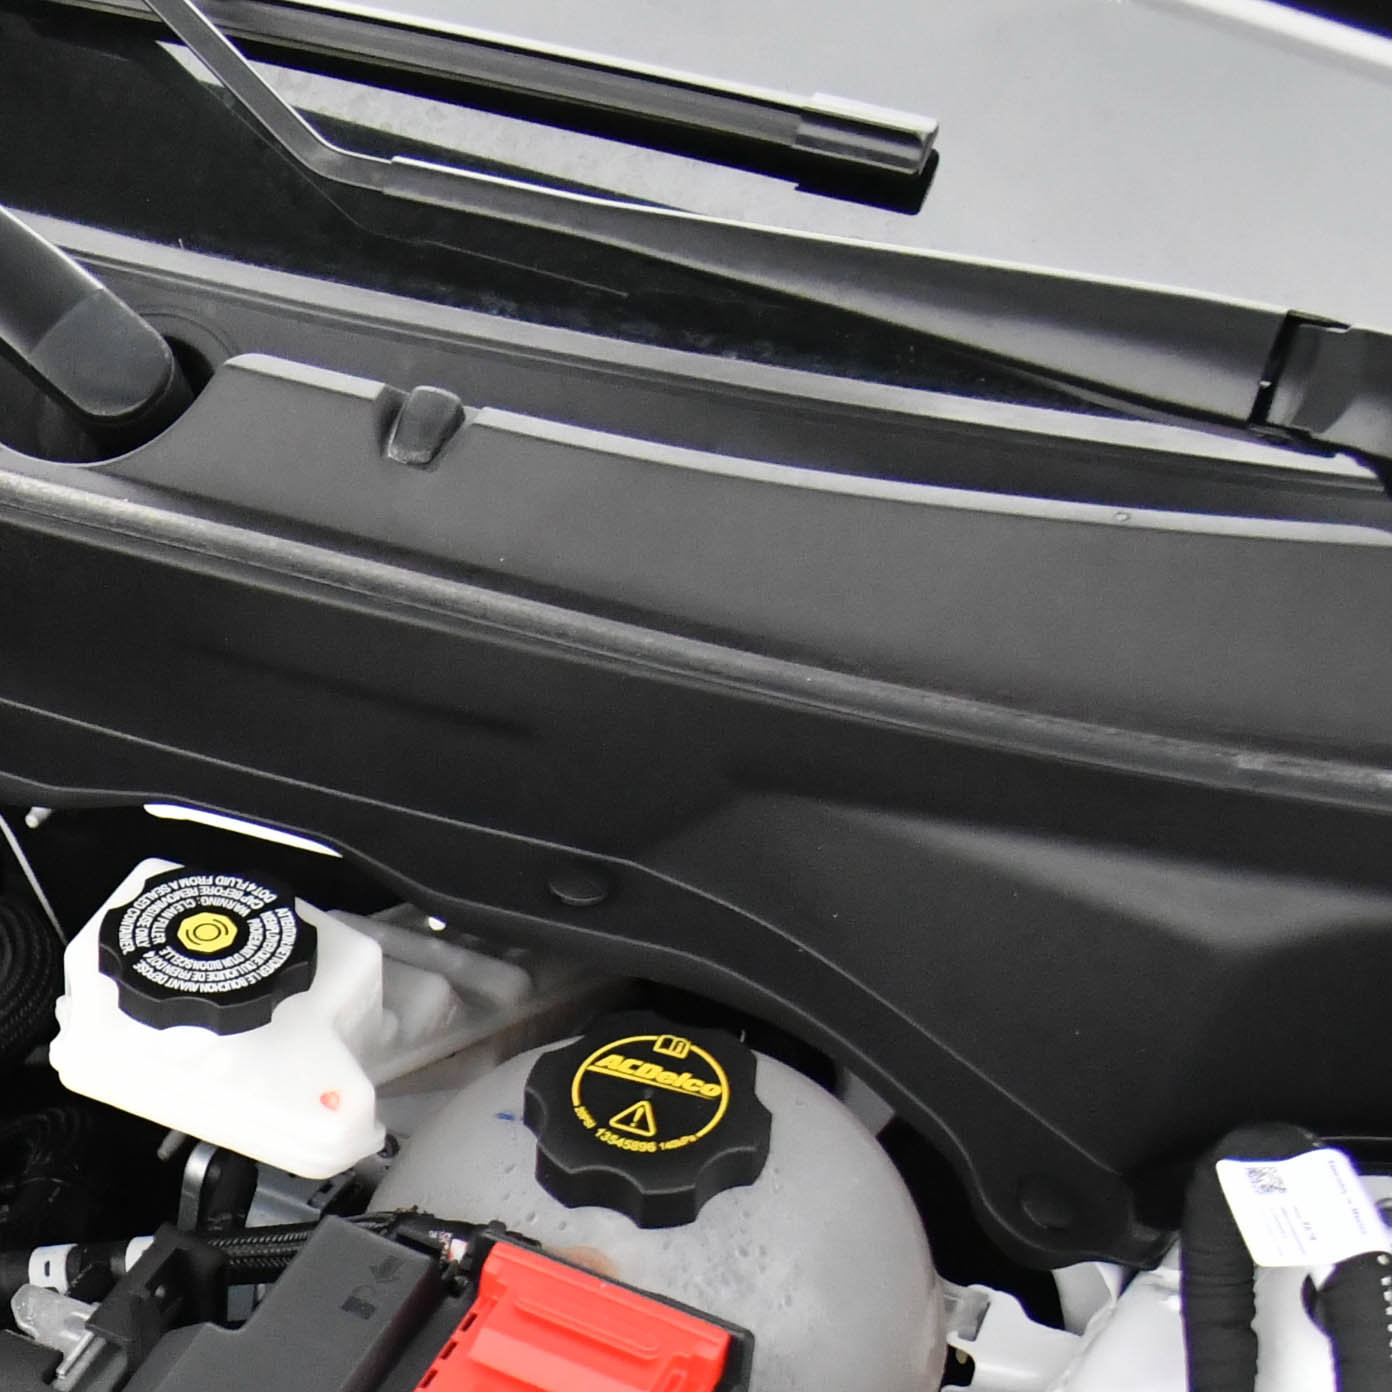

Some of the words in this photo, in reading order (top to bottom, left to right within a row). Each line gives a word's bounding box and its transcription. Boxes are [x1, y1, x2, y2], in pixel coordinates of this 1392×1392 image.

[167, 880, 179, 890] A
[178, 875, 214, 888] FROM
[214, 875, 250, 893] FLUID
[133, 883, 172, 910] SEALED
[198, 883, 245, 901] BEFORE
[160, 898, 197, 920] CLEAN
[195, 895, 251, 918] WARNING:
[239, 894, 265, 910] CAP
[132, 926, 151, 948] ONLY
[150, 915, 170, 945] FILLER
[161, 963, 193, 981] FREIN
[190, 970, 206, 982] DE
[206, 965, 245, 981] LIQUIDE
[164, 977, 200, 993] AVANT
[198, 976, 249, 993] BOUCHON
[592, 1054, 723, 1098] ACDelco
